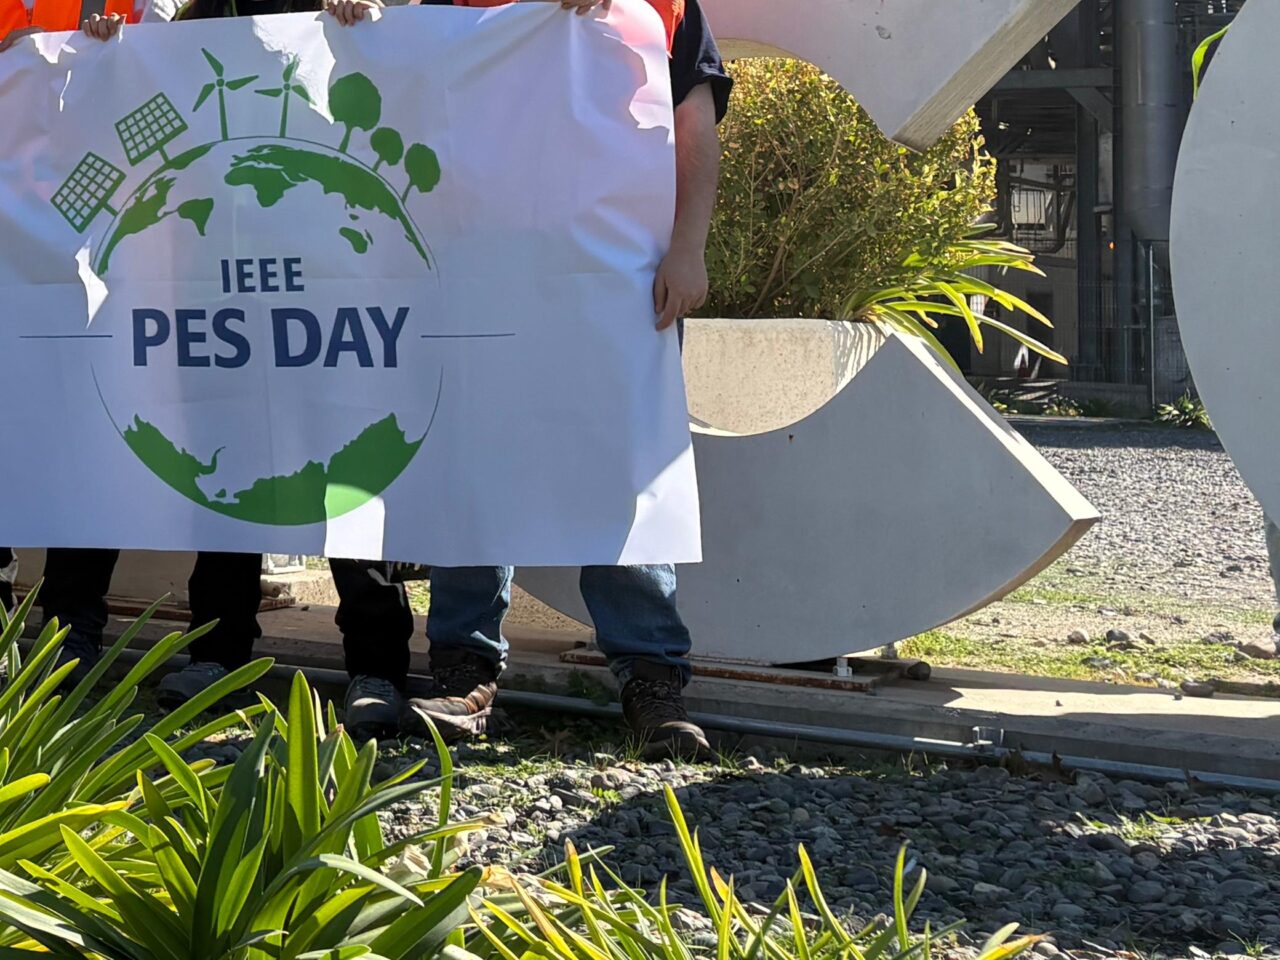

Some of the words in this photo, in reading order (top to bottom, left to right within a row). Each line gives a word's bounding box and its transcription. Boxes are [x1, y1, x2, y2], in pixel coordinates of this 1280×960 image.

[220, 256, 306, 294] IEEE
[131, 307, 252, 369] PES
[270, 306, 411, 369] DAY
